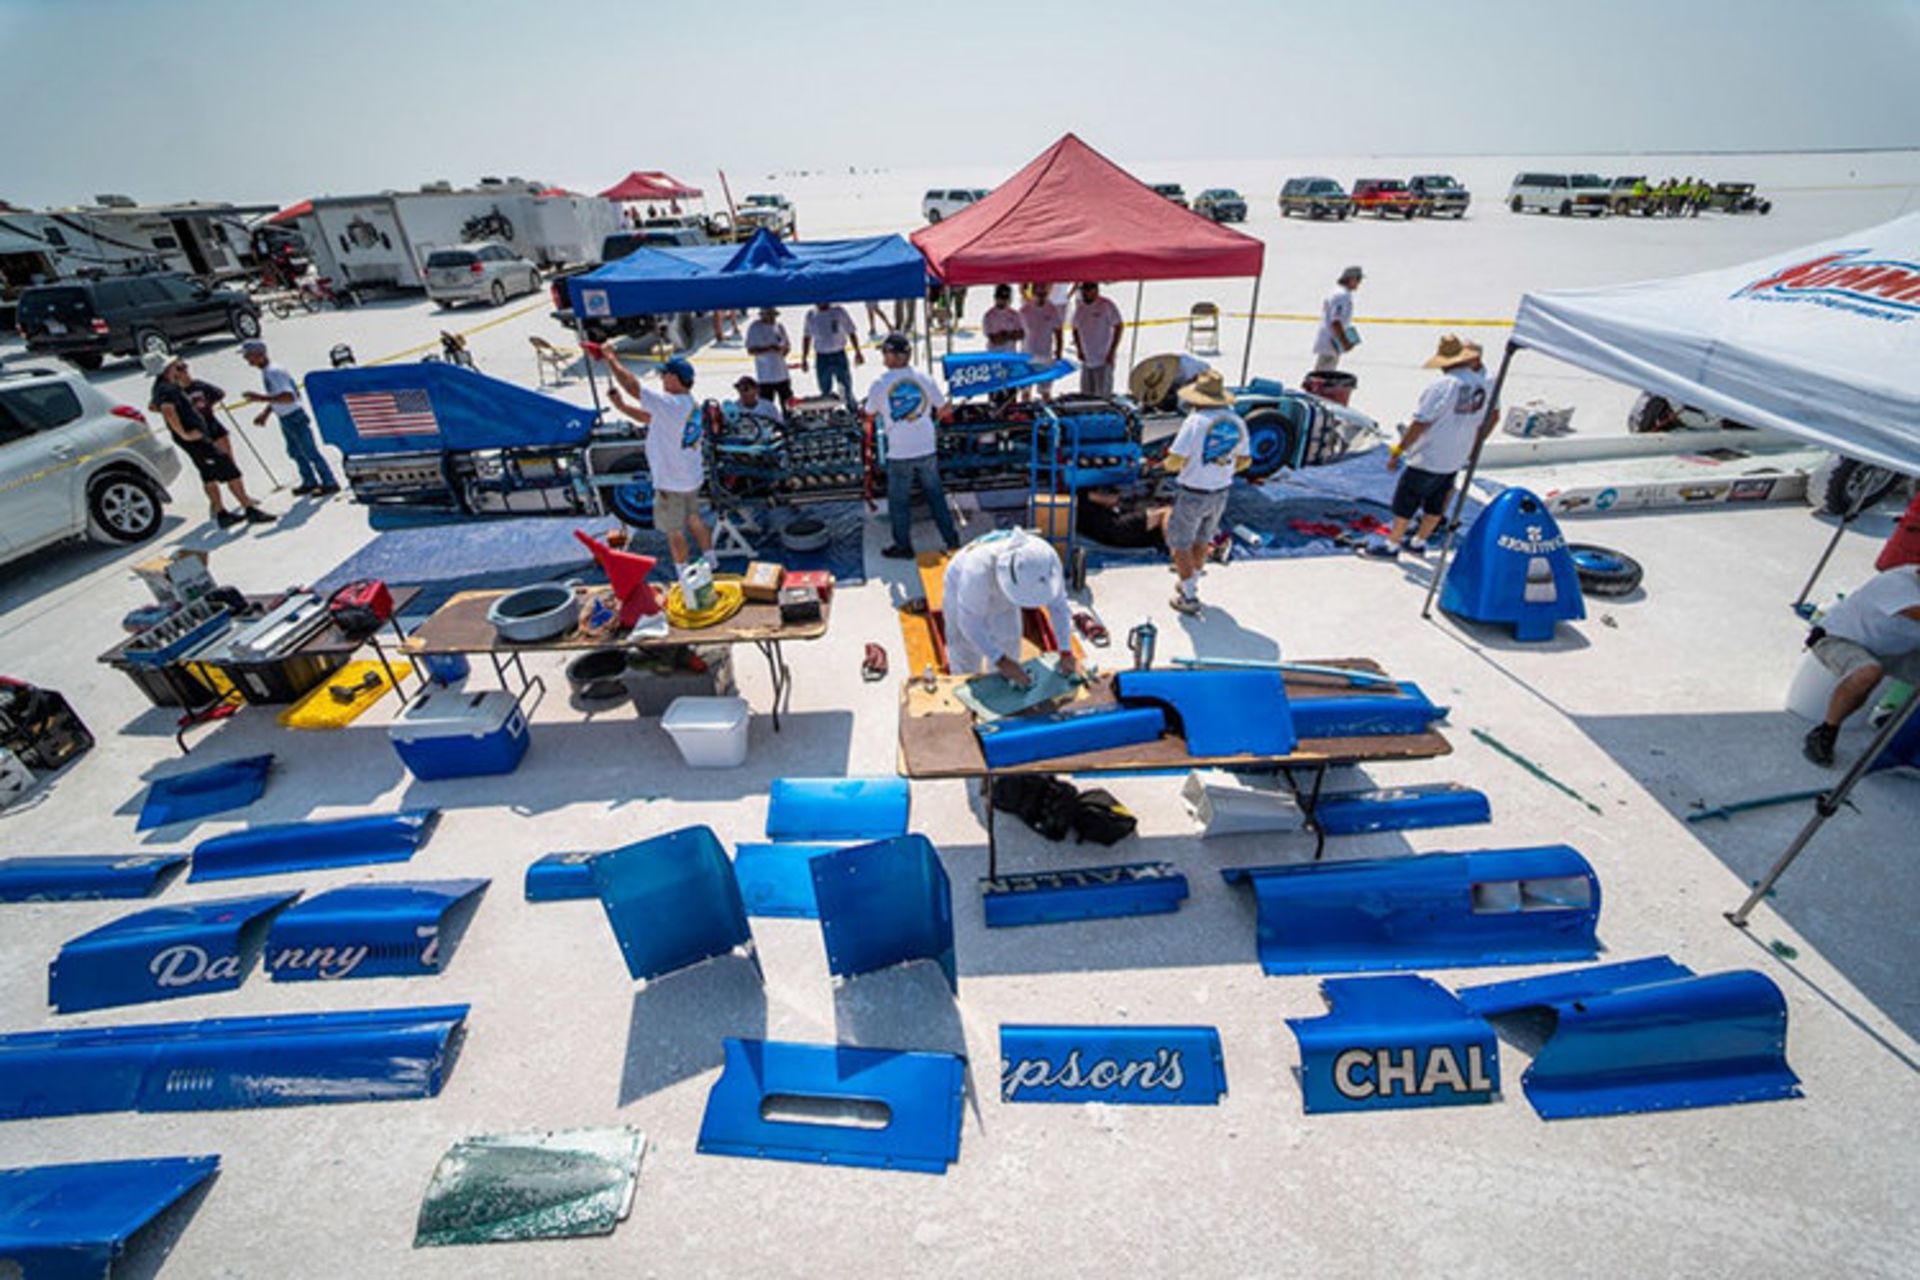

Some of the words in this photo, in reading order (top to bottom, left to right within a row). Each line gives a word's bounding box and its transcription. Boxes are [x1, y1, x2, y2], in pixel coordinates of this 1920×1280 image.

[1750, 251, 1920, 304] SUMM
[150, 945, 240, 987] Da
[1001, 1049, 1184, 1101] pson's
[1333, 1044, 1493, 1099] CHAL
